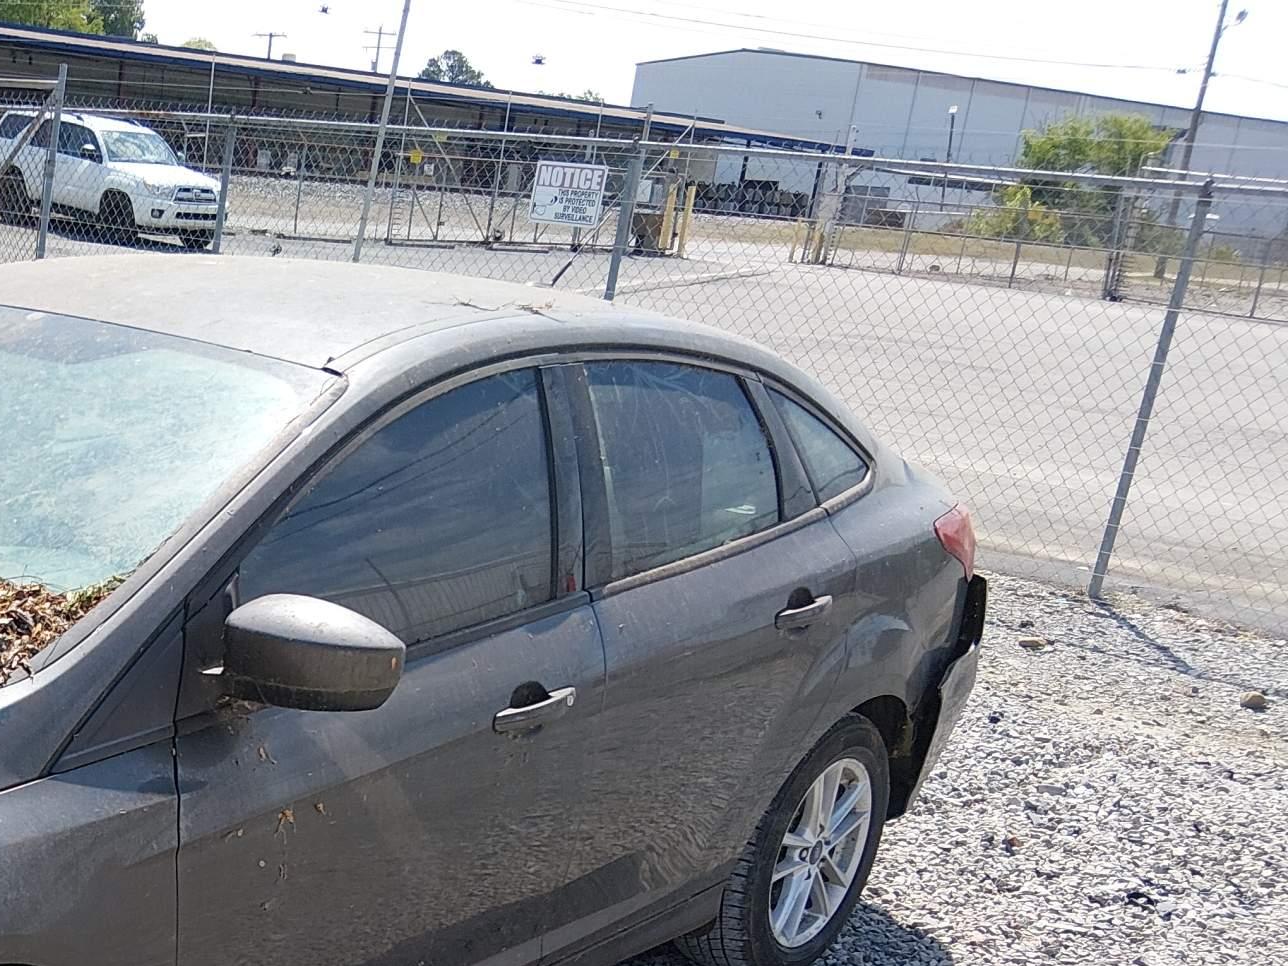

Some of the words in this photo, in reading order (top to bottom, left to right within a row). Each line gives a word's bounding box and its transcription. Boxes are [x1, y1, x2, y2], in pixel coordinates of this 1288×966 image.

[538, 165, 603, 190] NOTICE
[558, 189, 570, 197] THIS
[570, 190, 599, 199] PROPERTY
[565, 198, 596, 207] PROTECTED
[572, 206, 587, 214] VIDEO
[554, 212, 593, 223] SURVEILLANCE
